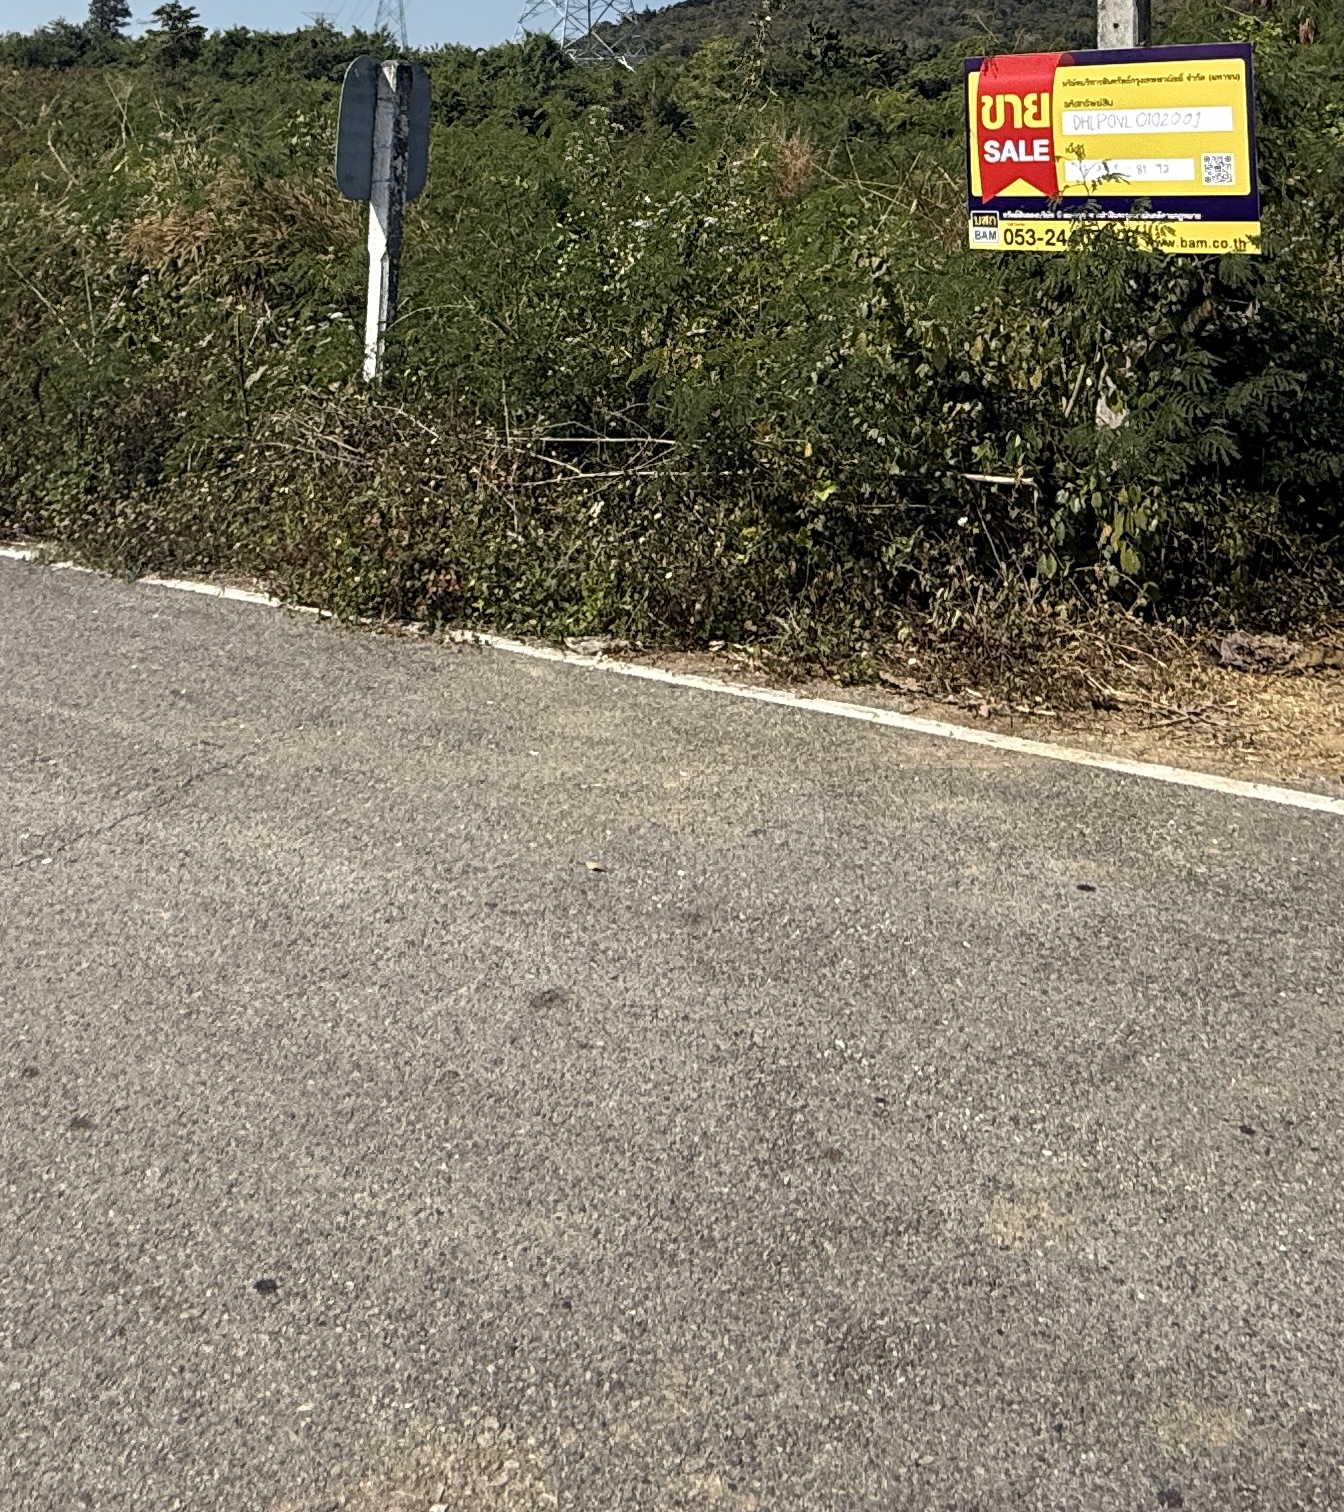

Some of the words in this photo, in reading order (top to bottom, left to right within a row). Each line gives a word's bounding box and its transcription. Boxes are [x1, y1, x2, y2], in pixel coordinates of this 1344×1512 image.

[981, 92, 1050, 130] ขาย
[983, 139, 1050, 163] SALE
[974, 230, 997, 241] BAM
